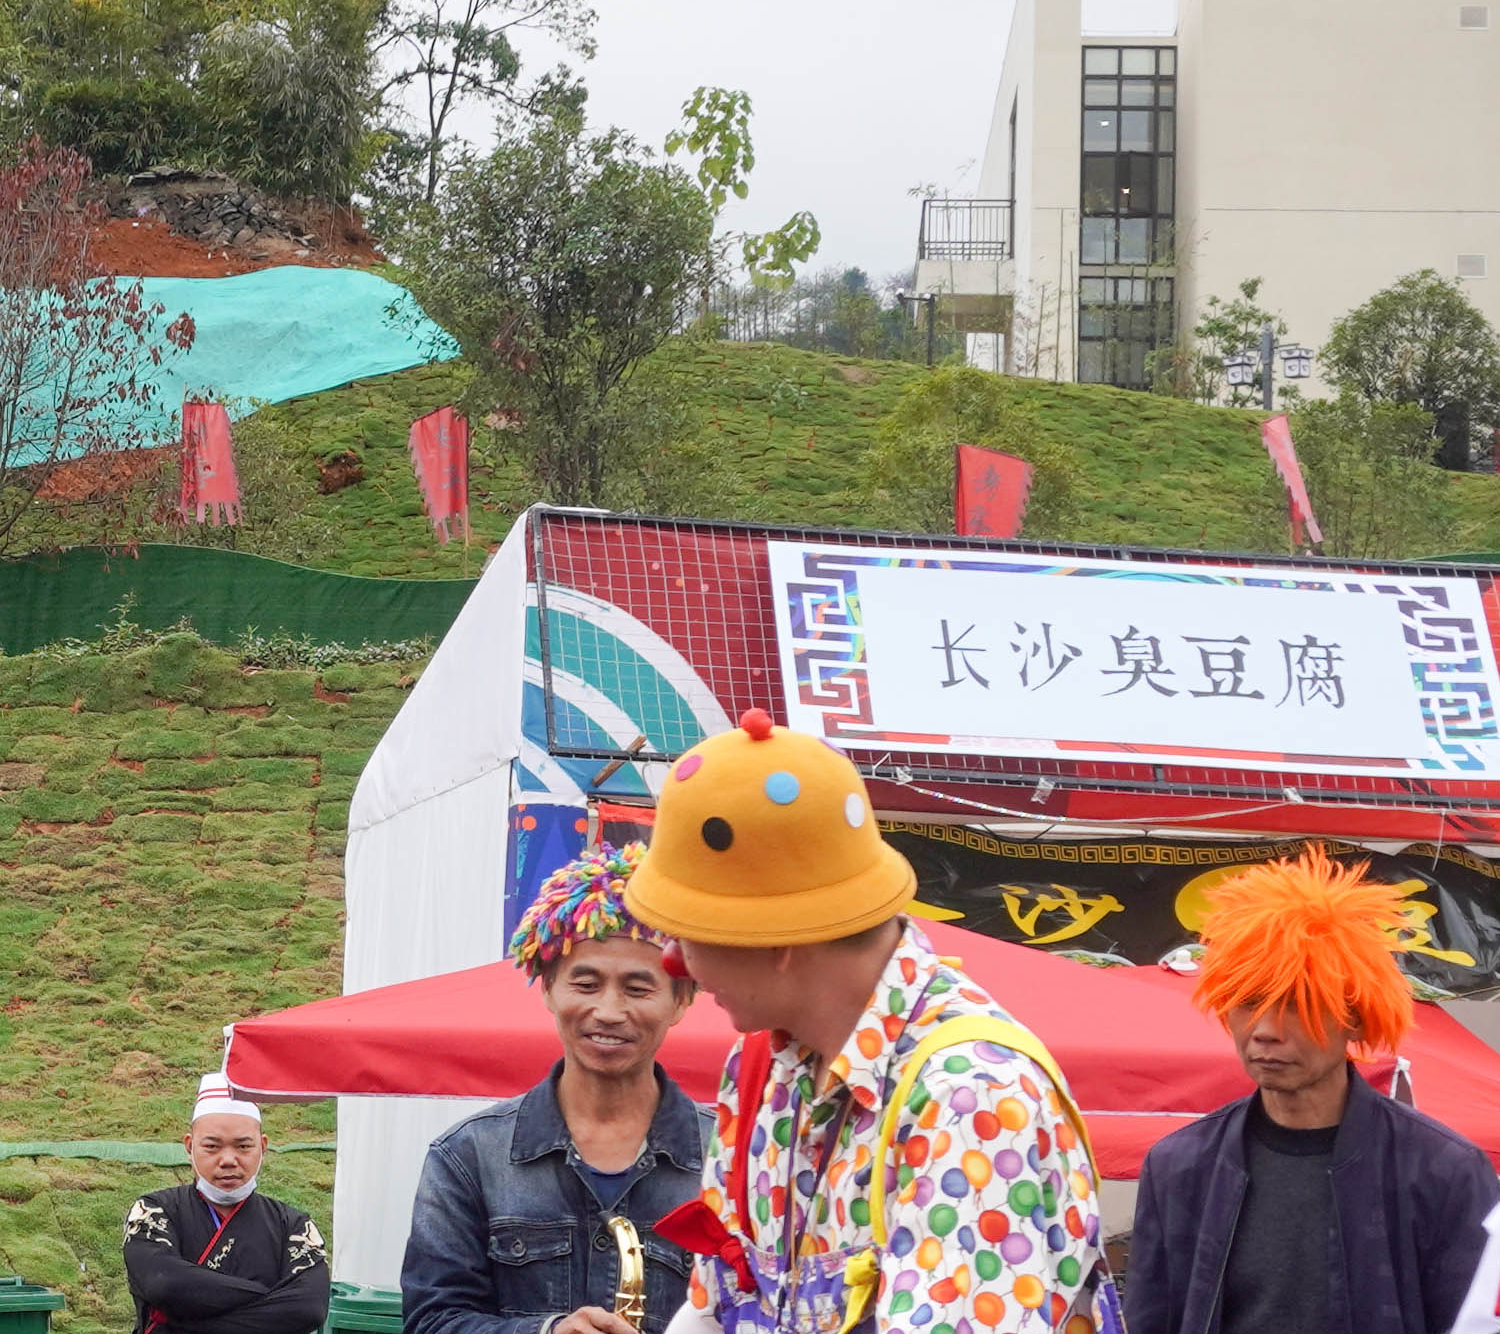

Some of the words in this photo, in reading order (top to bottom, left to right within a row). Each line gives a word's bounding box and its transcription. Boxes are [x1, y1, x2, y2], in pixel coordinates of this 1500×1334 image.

[930, 618, 1347, 709] 长沙臭豆腐
